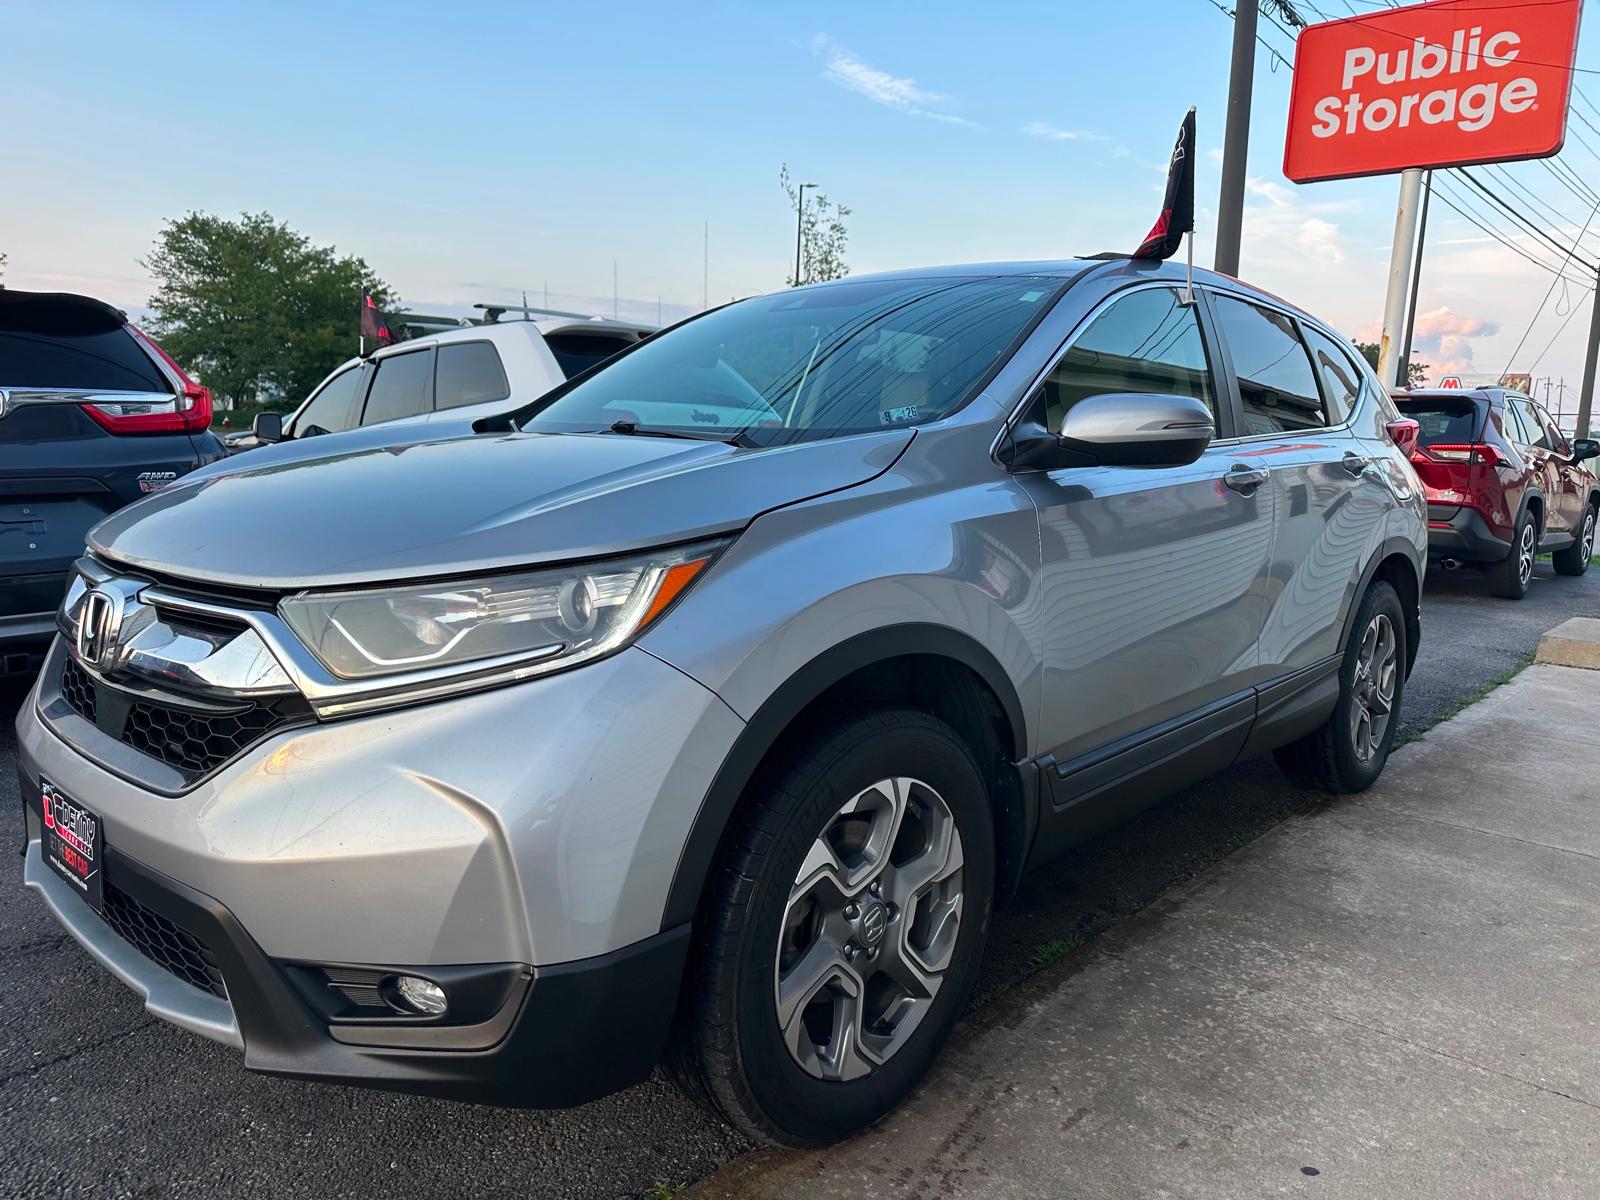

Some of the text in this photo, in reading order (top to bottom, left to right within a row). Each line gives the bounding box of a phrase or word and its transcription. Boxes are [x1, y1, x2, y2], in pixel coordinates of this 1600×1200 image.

[1341, 26, 1521, 91] Public
[905, 406, 917, 418] 26
[136, 471, 177, 480] AWD
